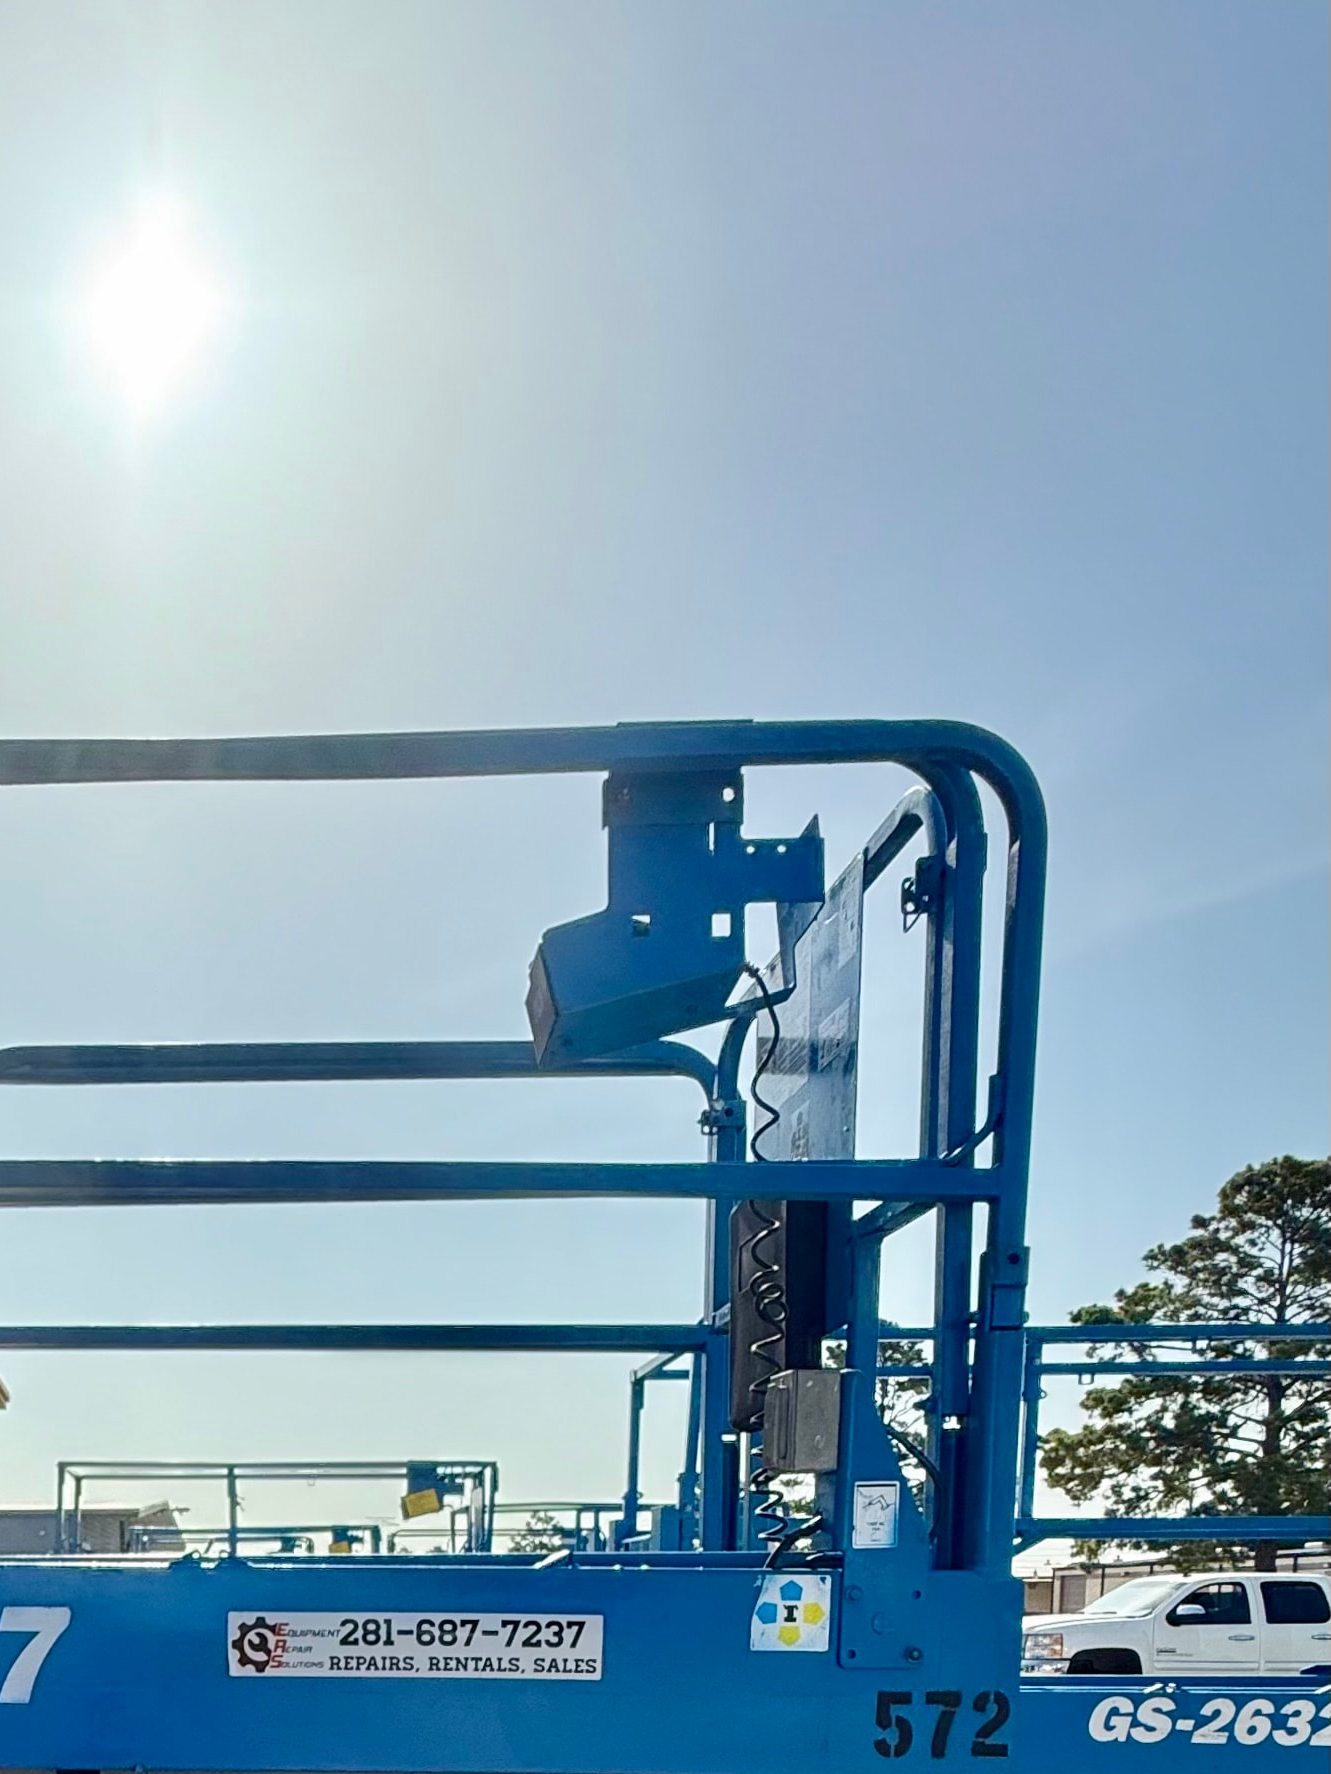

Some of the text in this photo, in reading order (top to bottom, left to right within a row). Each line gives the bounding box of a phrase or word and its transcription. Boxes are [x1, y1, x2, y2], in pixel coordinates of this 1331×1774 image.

[339, 1618, 586, 1649] 281-687-7237
[328, 1654, 597, 1674] REPAIRS, RENTALS, SALES
[873, 1689, 1011, 1760] 572
